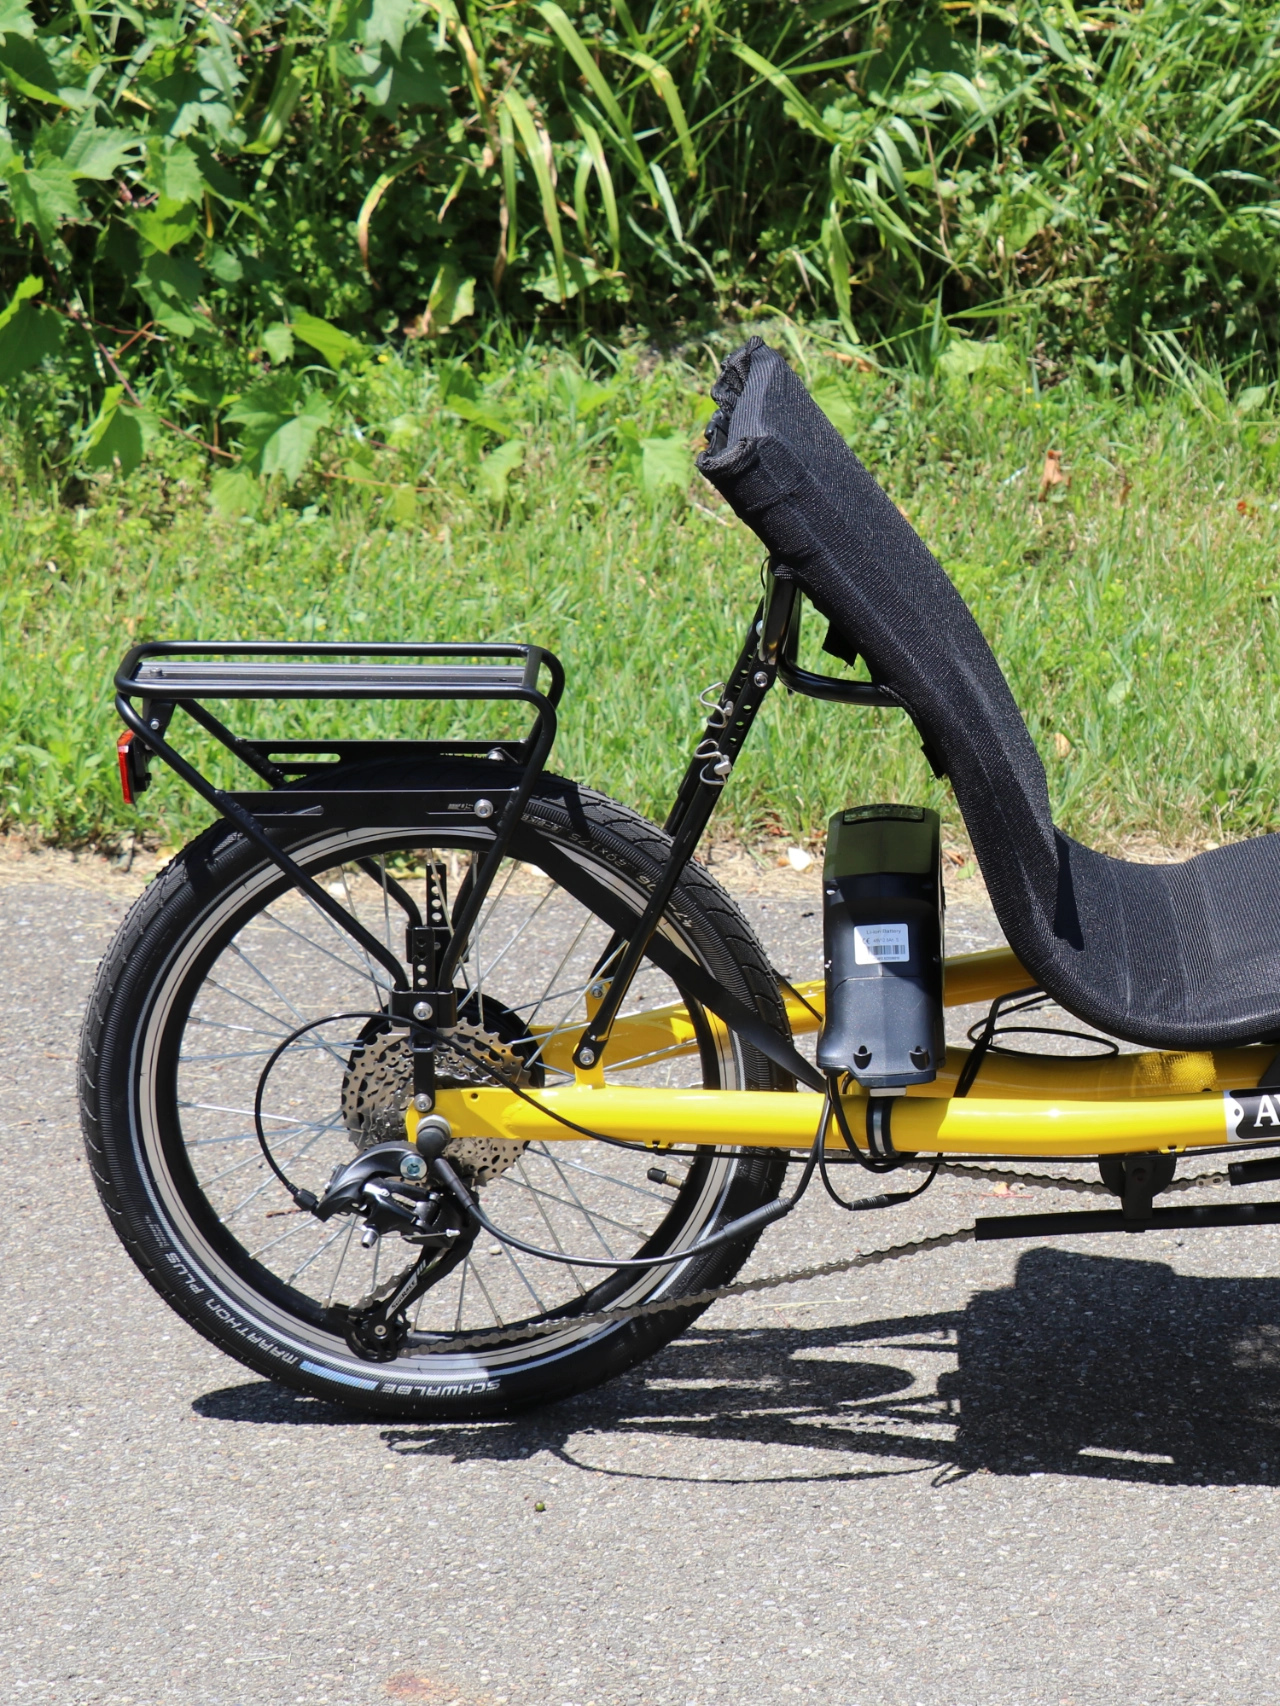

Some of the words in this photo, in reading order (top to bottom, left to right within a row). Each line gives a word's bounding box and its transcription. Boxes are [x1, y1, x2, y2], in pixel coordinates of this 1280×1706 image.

[165, 1252, 205, 1295] PLUS
[205, 1298, 299, 1365] MARATHON
[381, 1379, 501, 1396] SCHWALBE
